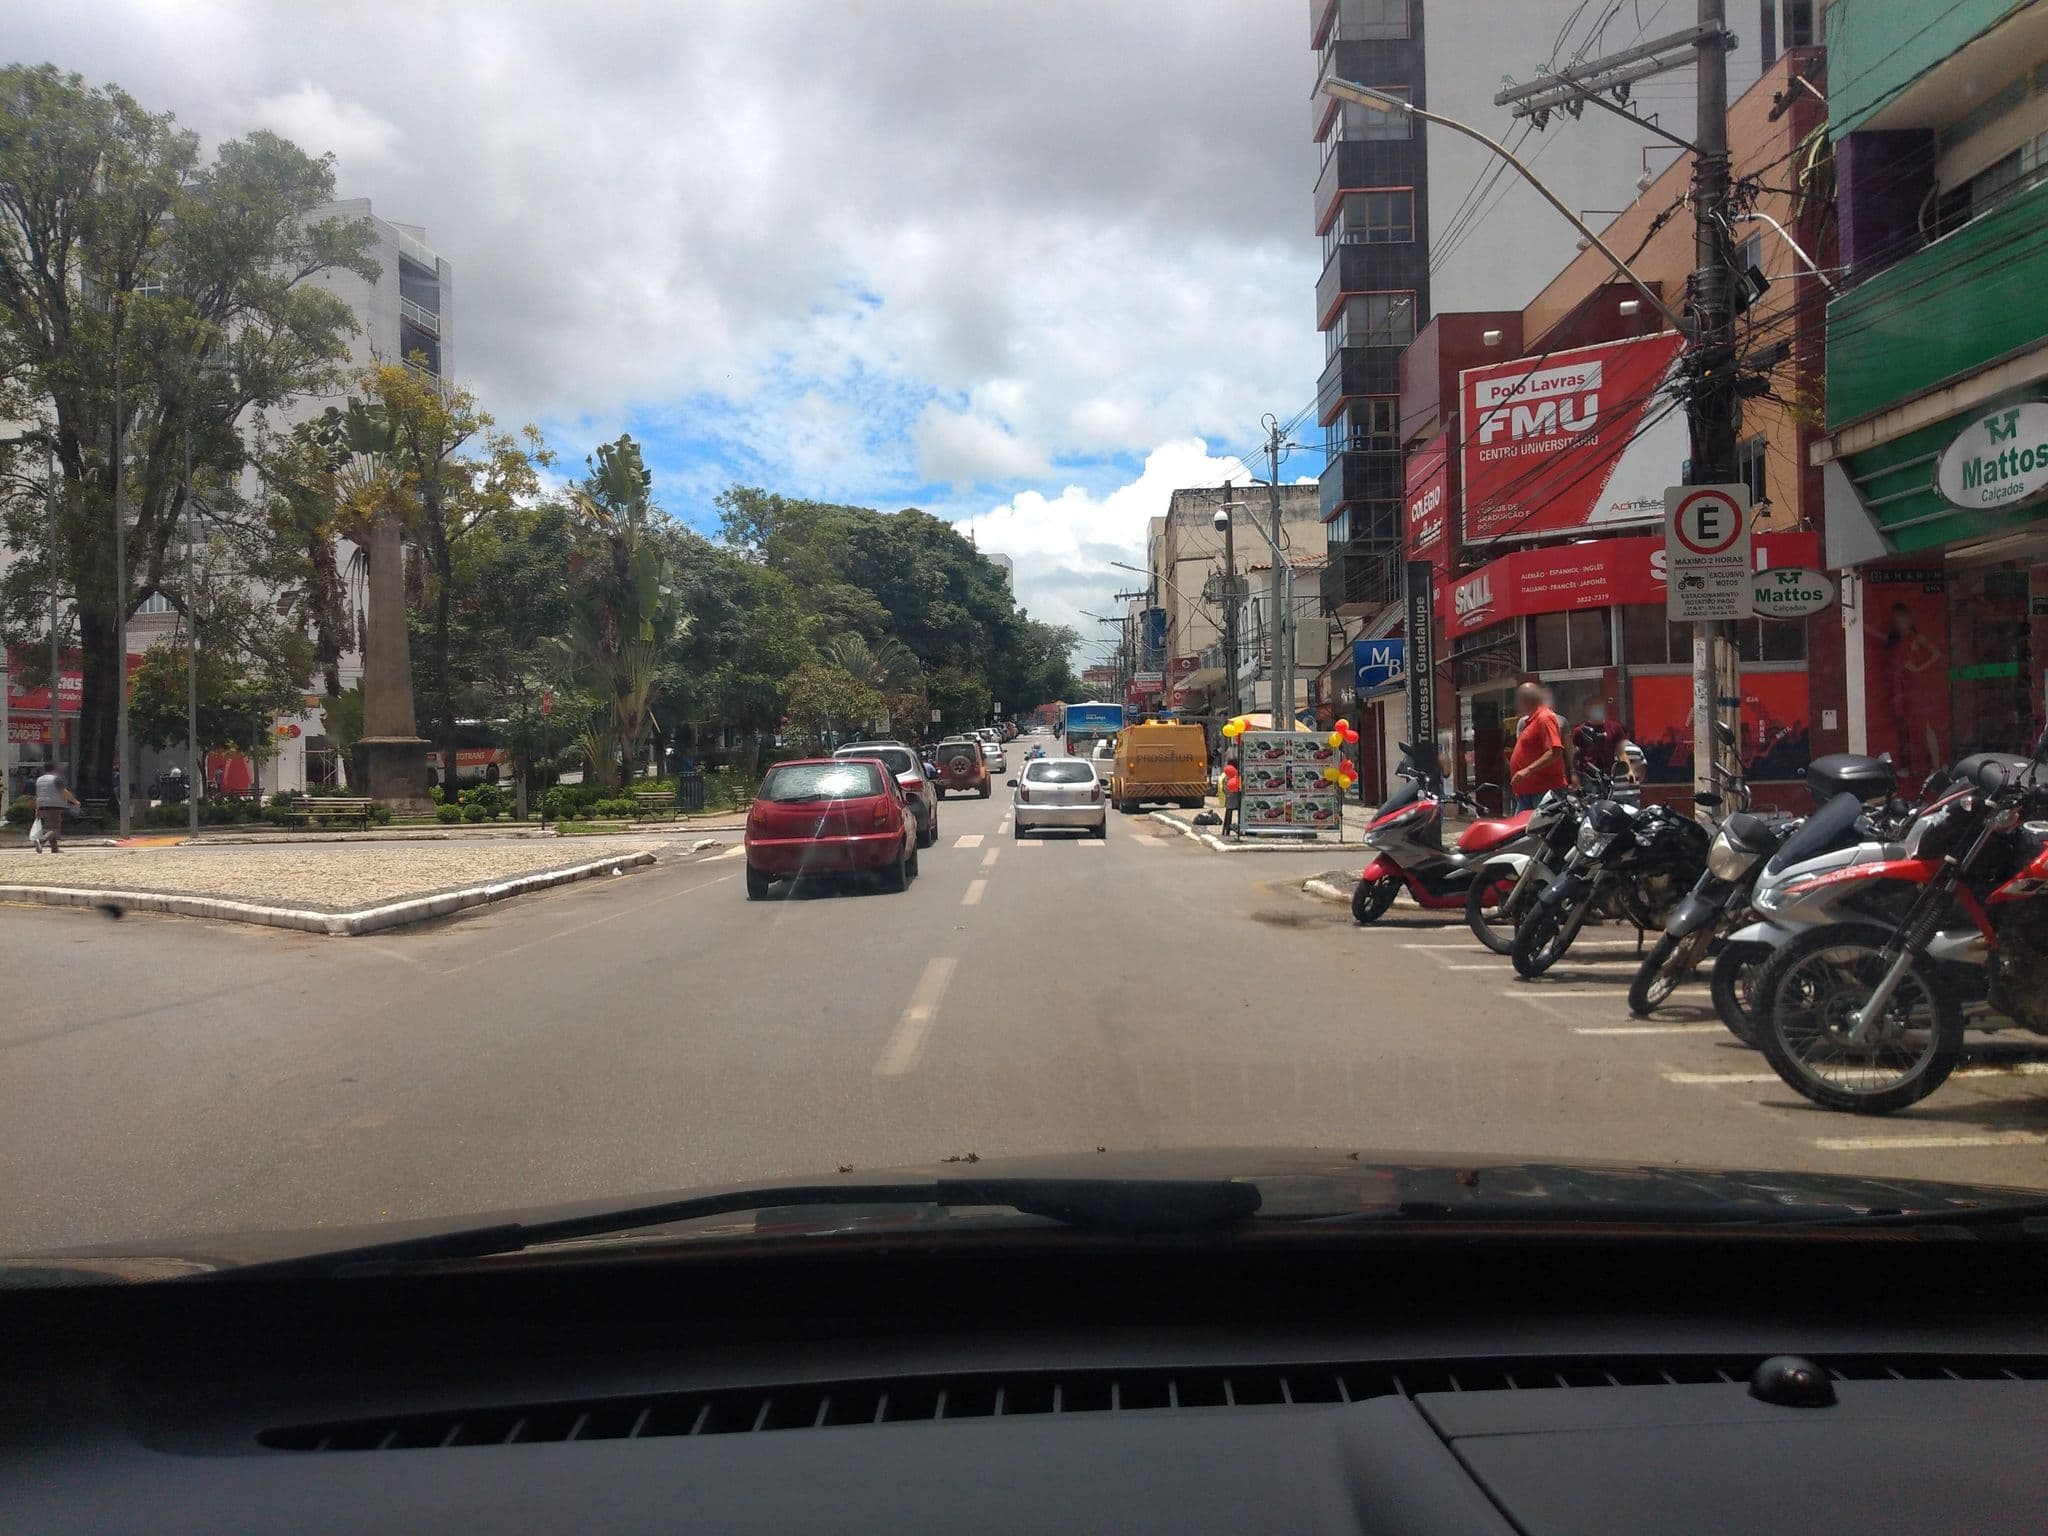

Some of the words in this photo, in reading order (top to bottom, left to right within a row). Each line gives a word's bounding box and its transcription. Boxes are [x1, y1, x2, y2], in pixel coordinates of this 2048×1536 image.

[1491, 383, 1526, 399] Polo
[1531, 374, 1585, 393] Lavras
[1480, 393, 1598, 445] FMU
[1480, 446, 1518, 461] CENTRO
[1521, 434, 1599, 456] UNIVERSITÁRIO
[1962, 444, 2048, 490] Mattos
[1411, 486, 1440, 523] COLÉGIO
[1981, 482, 2024, 502] Calçados
[1697, 506, 1719, 539] E
[1521, 570, 1545, 580] ALEMÃO
[1549, 567, 1580, 576] ESPANHOL
[1582, 563, 1604, 572] INGLÊS
[1715, 556, 1743, 564] HORAS
[1455, 574, 1494, 615] SKILL
[1521, 585, 1547, 593] ITALIANO
[1550, 581, 1577, 590] FRANCÊS
[1579, 577, 1606, 587] JAPONÊS
[1755, 588, 1823, 602] Mattos
[1415, 596, 1428, 673] Guadalupe
[1418, 678, 1430, 743] Travessa
[8, 729, 41, 740] OVID-19
[456, 751, 485, 760] TOTRANS
